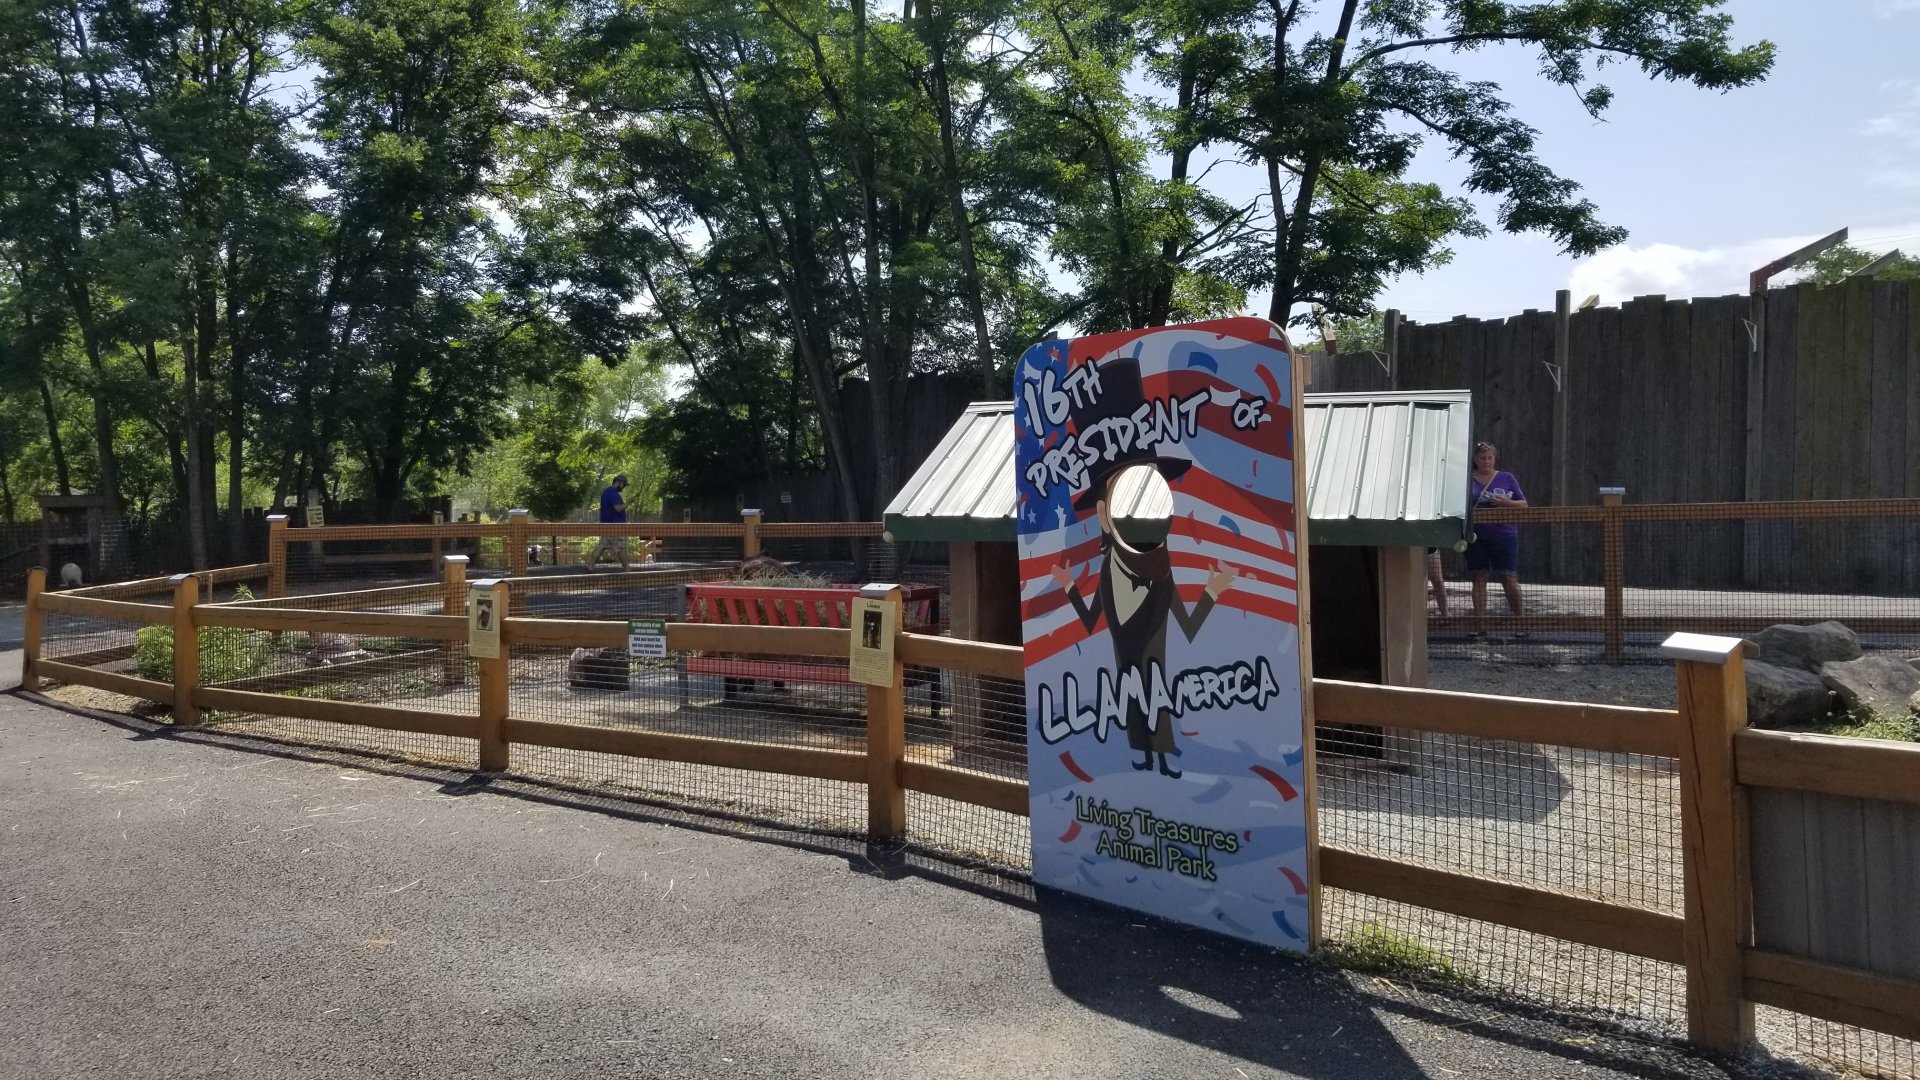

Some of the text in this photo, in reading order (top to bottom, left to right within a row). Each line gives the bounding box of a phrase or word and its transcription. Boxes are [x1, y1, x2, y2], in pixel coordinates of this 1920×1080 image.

[1022, 357, 1104, 438] 16TH
[1024, 391, 1265, 498] PRESIDENT OF
[1076, 796, 1238, 852] Living Treasures
[1097, 831, 1217, 881] Animal Park
